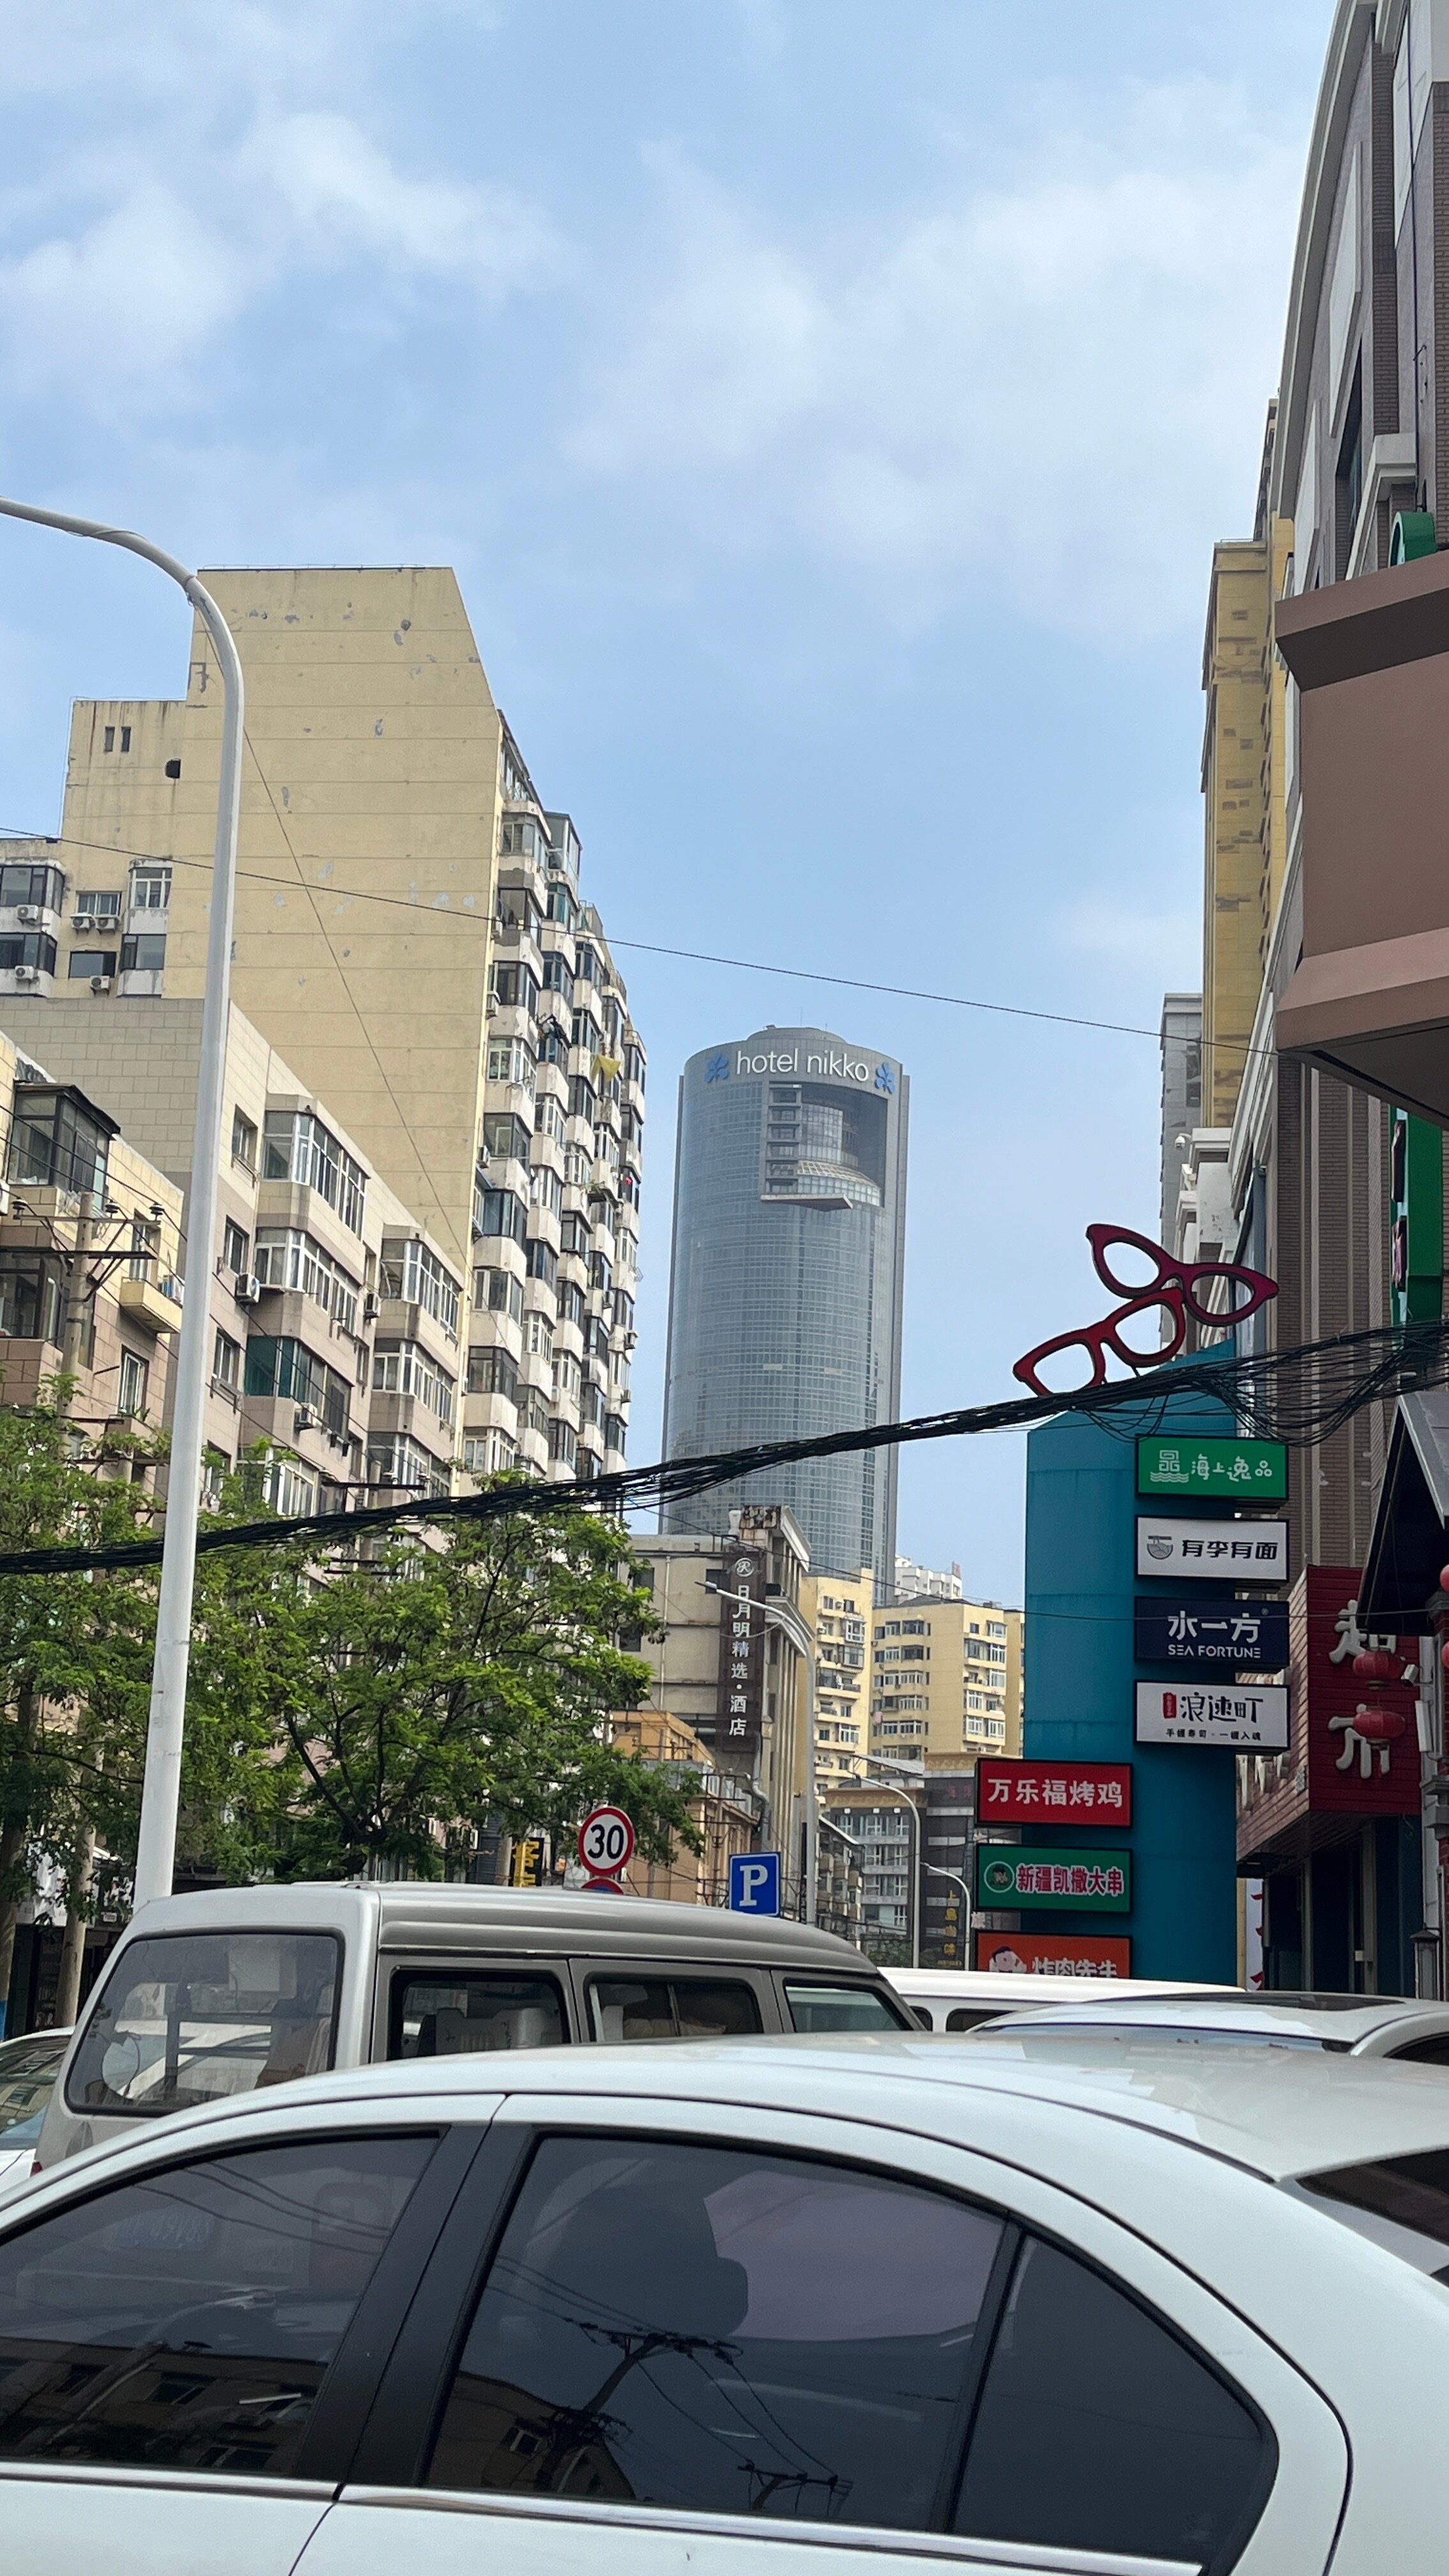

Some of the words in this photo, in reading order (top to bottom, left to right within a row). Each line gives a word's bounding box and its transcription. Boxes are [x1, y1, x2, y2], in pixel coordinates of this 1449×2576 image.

[737, 1047, 798, 1075] hotel
[807, 1050, 869, 1082] nikko
[1167, 1610, 1261, 1644] 水一方
[1168, 1644, 1194, 1657] SEA
[1198, 1645, 1261, 1659] FORTUNE
[1180, 1692, 1264, 1723] 浪速町
[988, 1779, 1123, 1808] 万乐福烤鸡
[587, 1824, 624, 1859] 30
[739, 1864, 768, 1907] P
